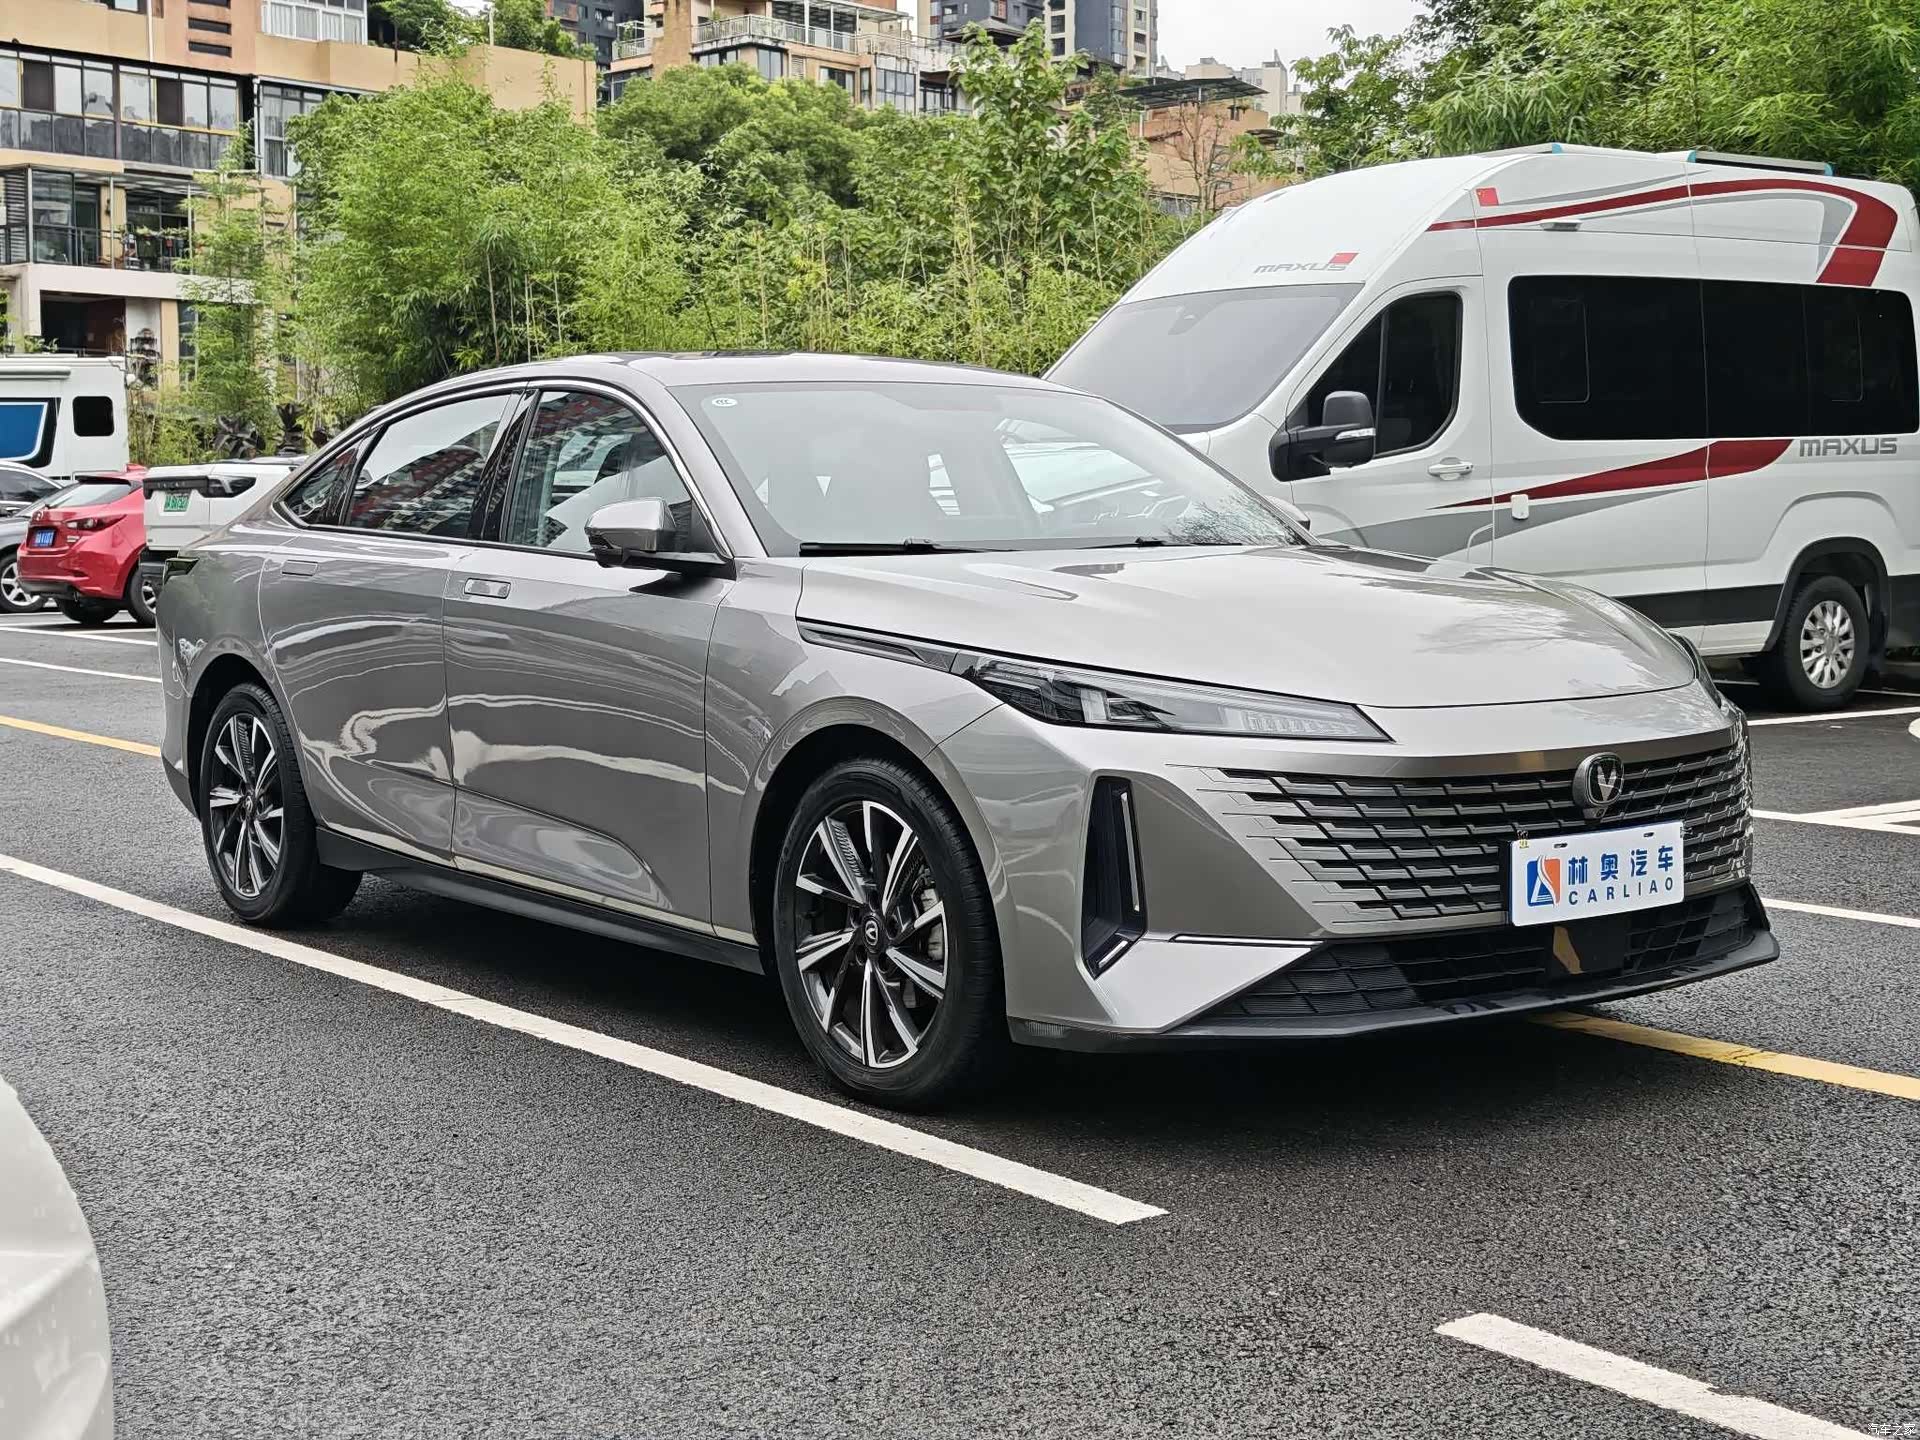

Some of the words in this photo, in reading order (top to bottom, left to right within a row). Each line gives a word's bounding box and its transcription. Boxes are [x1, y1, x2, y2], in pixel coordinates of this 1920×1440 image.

[1254, 262, 1347, 273] MAXUS
[1800, 437, 1897, 457] MAXUS
[1568, 845, 1673, 885] 林奥汽车
[1568, 877, 1673, 905] CARLIAO
